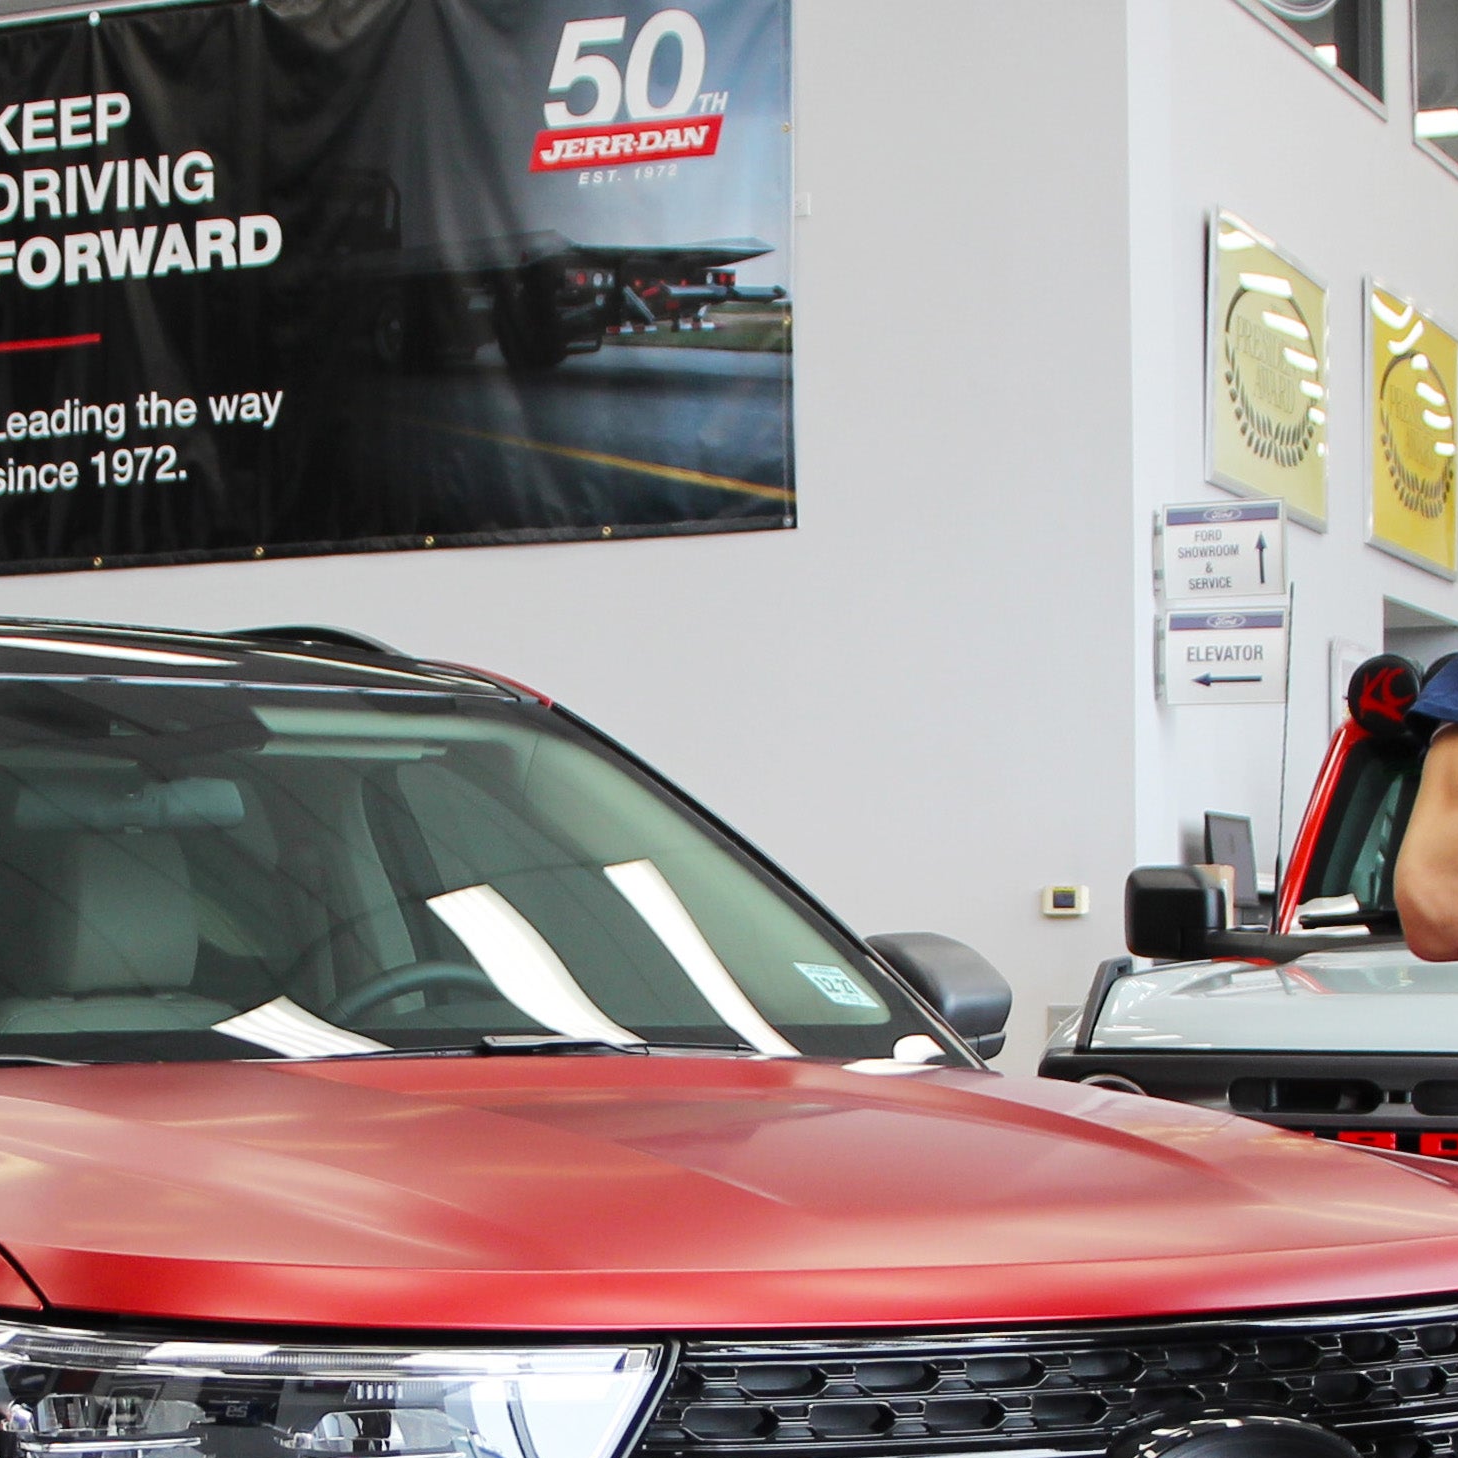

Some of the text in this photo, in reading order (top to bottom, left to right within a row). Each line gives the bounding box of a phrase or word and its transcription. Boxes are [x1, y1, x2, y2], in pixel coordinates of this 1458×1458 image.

[578, 164, 678, 185] EST. 1972
[136, 391, 198, 427] the
[208, 390, 284, 430] way
[91, 445, 188, 487] 1972.
[1194, 529, 1222, 542] FORD
[1177, 544, 1240, 560] SHOWROOM
[1205, 561, 1214, 574] &
[1188, 576, 1233, 591] SERVICE
[1209, 614, 1241, 628] Ford
[1186, 644, 1264, 662] ELEVATOR
